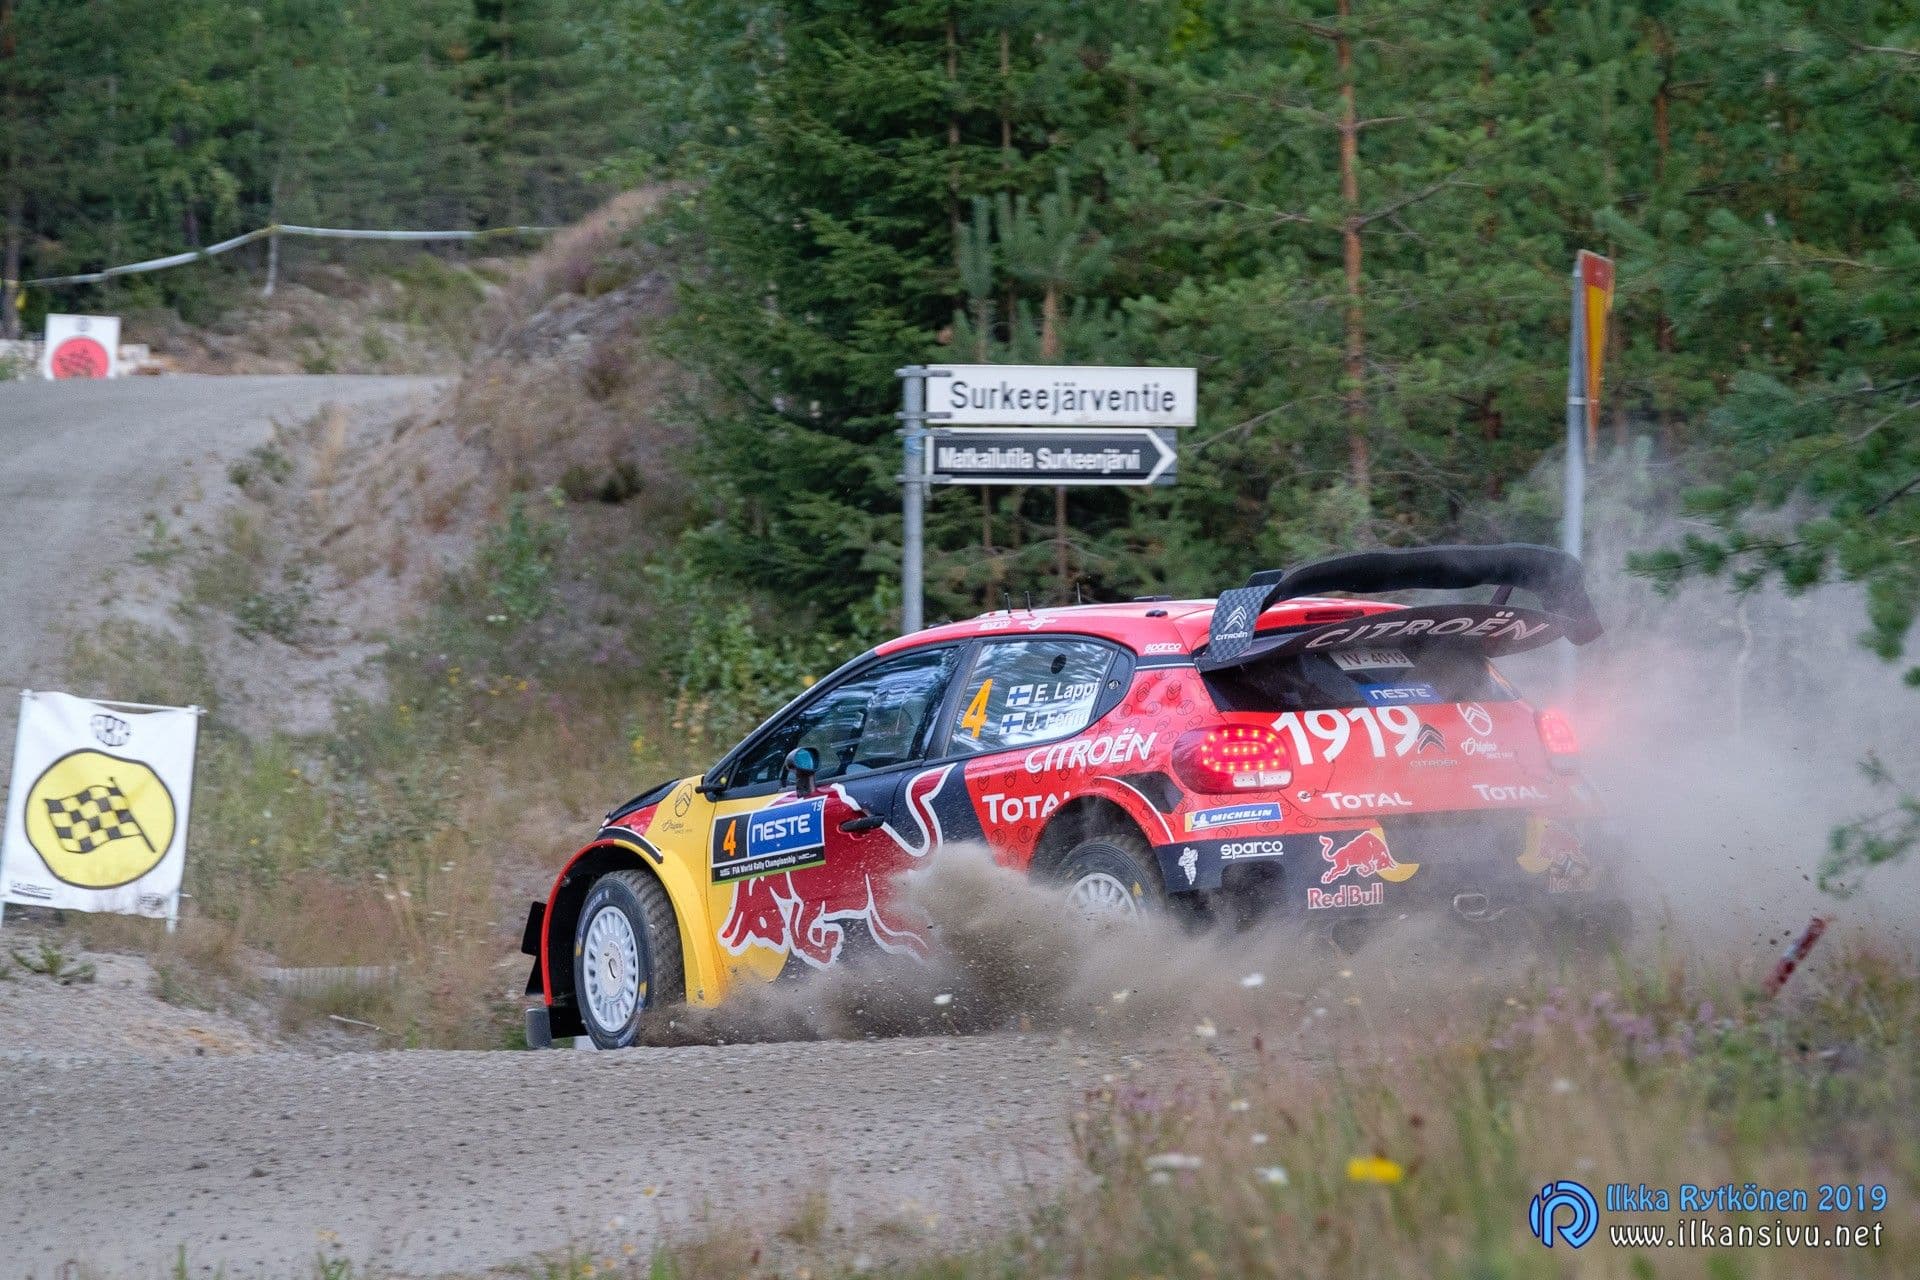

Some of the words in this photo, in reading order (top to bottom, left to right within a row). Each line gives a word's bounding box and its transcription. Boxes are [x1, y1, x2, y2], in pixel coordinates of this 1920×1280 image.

[950, 381, 1176, 415] Surkeejärventie
[1305, 611, 1550, 649] CITROËN
[1034, 684, 1049, 702] E.
[1054, 677, 1101, 702] Lappi
[1370, 688, 1431, 700] NESTE
[961, 678, 993, 739] 4
[1024, 727, 1157, 774] CITROËN
[1271, 705, 1420, 766] 1919
[982, 791, 1071, 824] TOTA
[1211, 809, 1273, 822] MICHELIN
[1322, 792, 1413, 811] TOTAL
[723, 819, 737, 857] 4
[752, 814, 811, 843] NESTE
[1220, 841, 1284, 860] sparco
